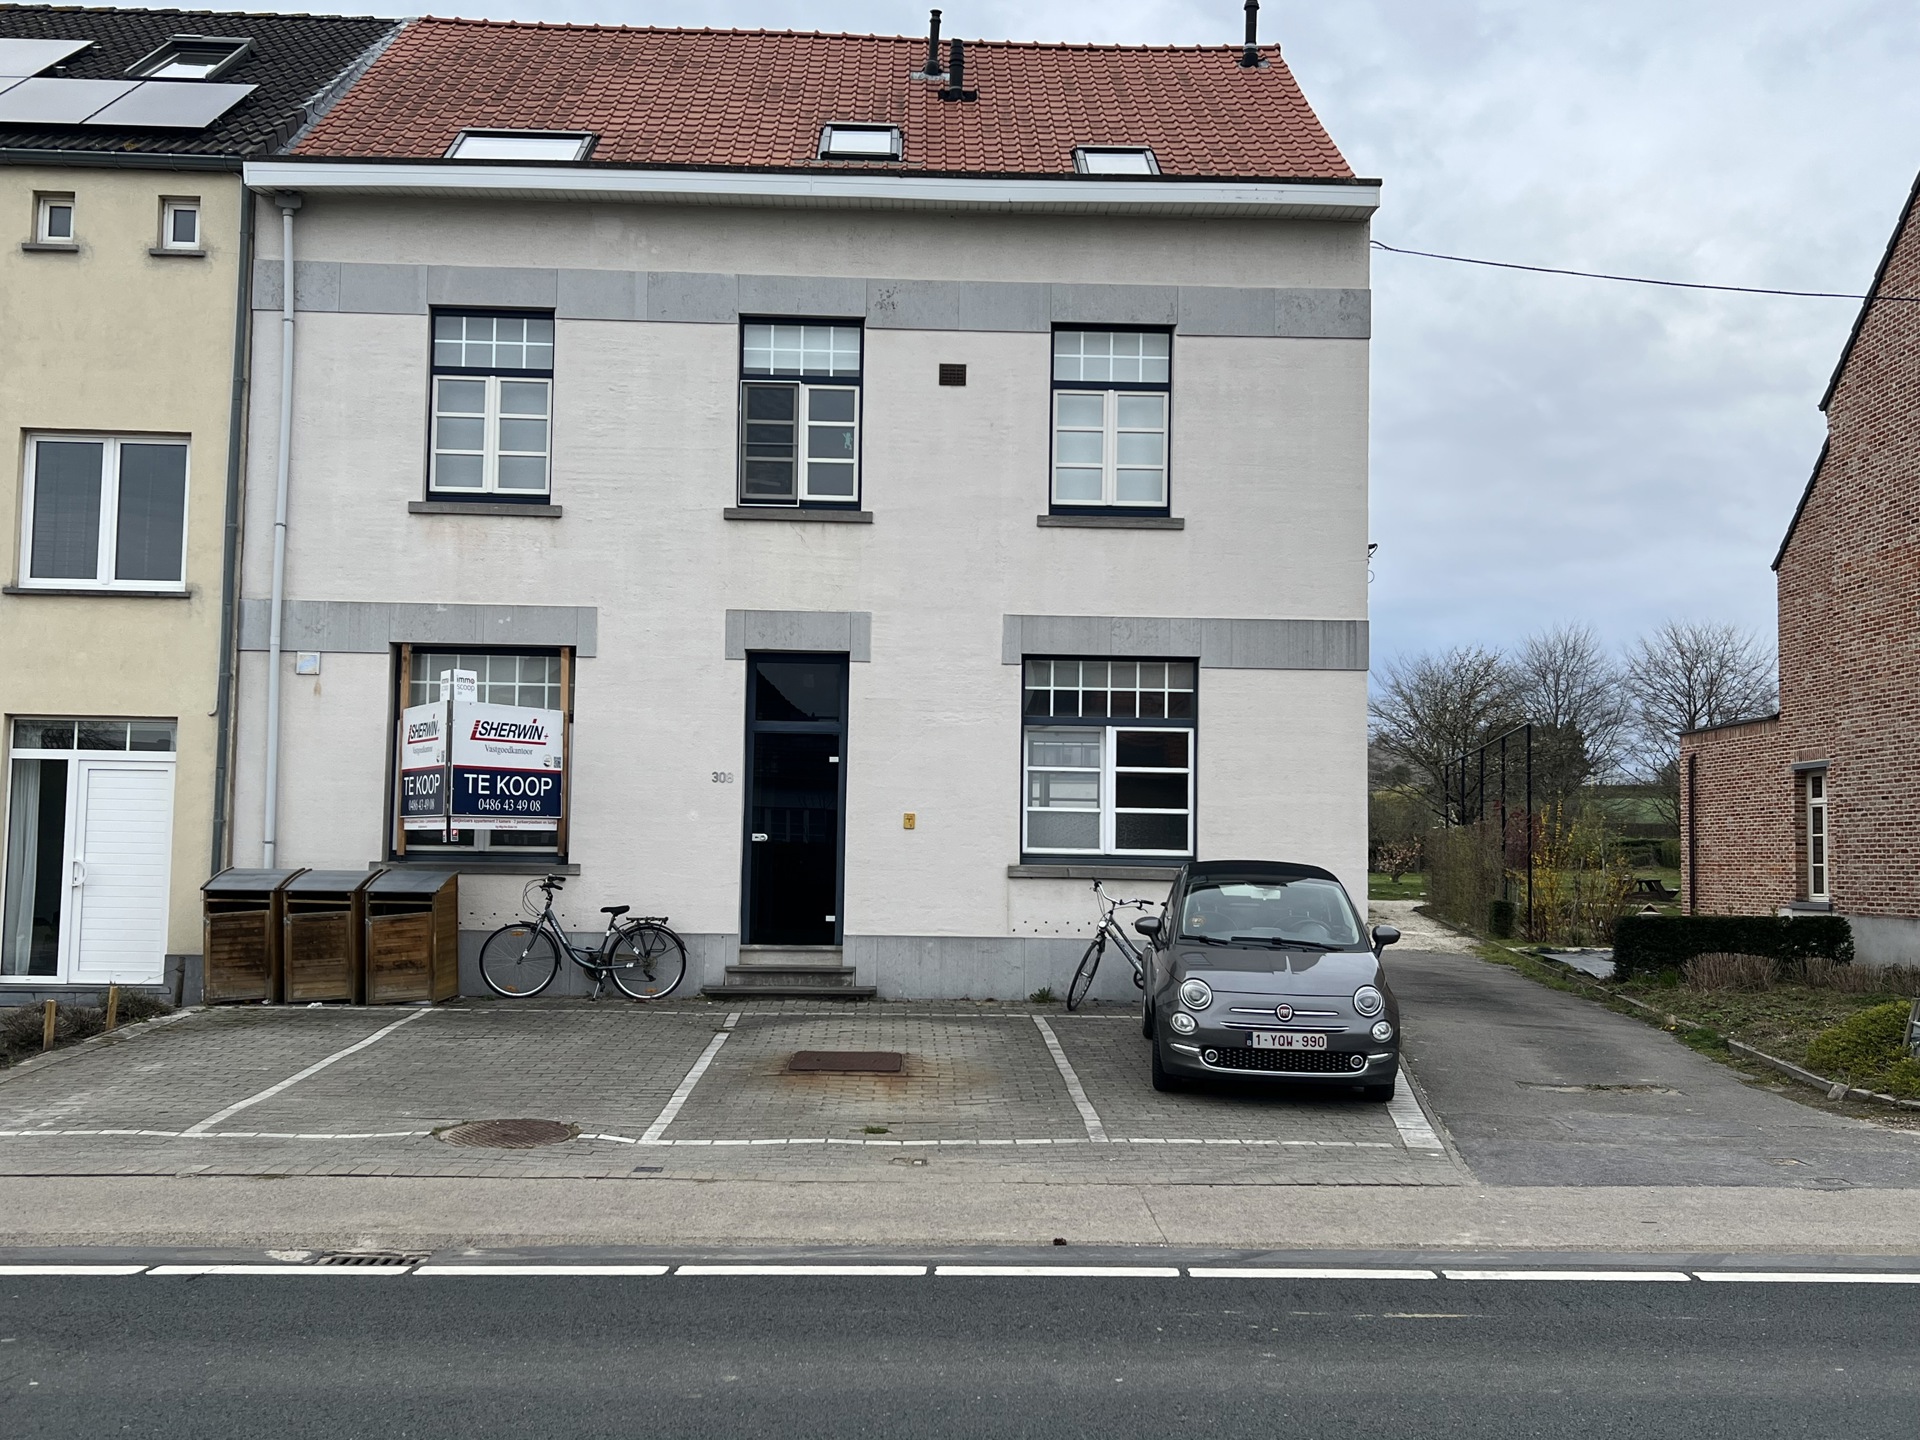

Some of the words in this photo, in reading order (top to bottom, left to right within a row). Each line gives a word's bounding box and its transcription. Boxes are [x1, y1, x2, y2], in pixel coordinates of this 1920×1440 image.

[456, 674, 475, 684] immo
[456, 684, 475, 693] scoop
[485, 744, 534, 756] Vastgoedkantoor
[711, 771, 734, 784] 308
[404, 777, 414, 796] TE
[415, 773, 441, 796] KOOP
[464, 773, 490, 795] TE
[497, 775, 552, 797] KOOP
[478, 798, 501, 811] 0486
[503, 799, 514, 811] 43
[516, 800, 528, 812] 49
[530, 800, 541, 812] 08
[1256, 1033, 1325, 1048] 1-YQW-990
